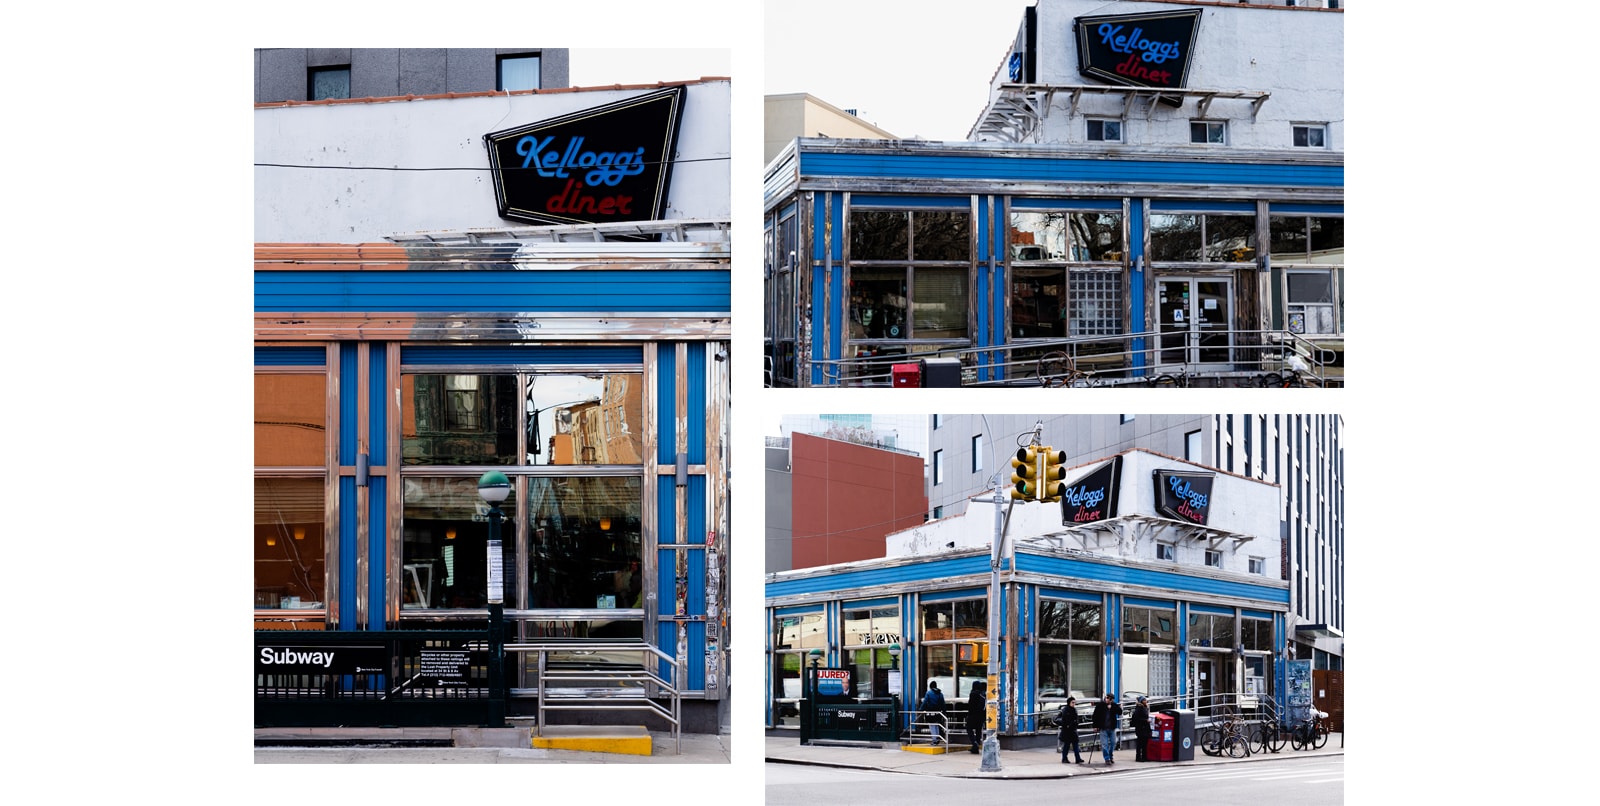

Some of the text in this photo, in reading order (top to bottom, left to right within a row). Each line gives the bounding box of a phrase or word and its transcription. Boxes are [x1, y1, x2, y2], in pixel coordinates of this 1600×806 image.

[1116, 53, 1172, 85] diner
[547, 178, 633, 215] diner
[1074, 506, 1101, 522] diner
[1178, 500, 1204, 525] diner
[260, 647, 335, 668] Subway
[837, 710, 856, 719] Subway
